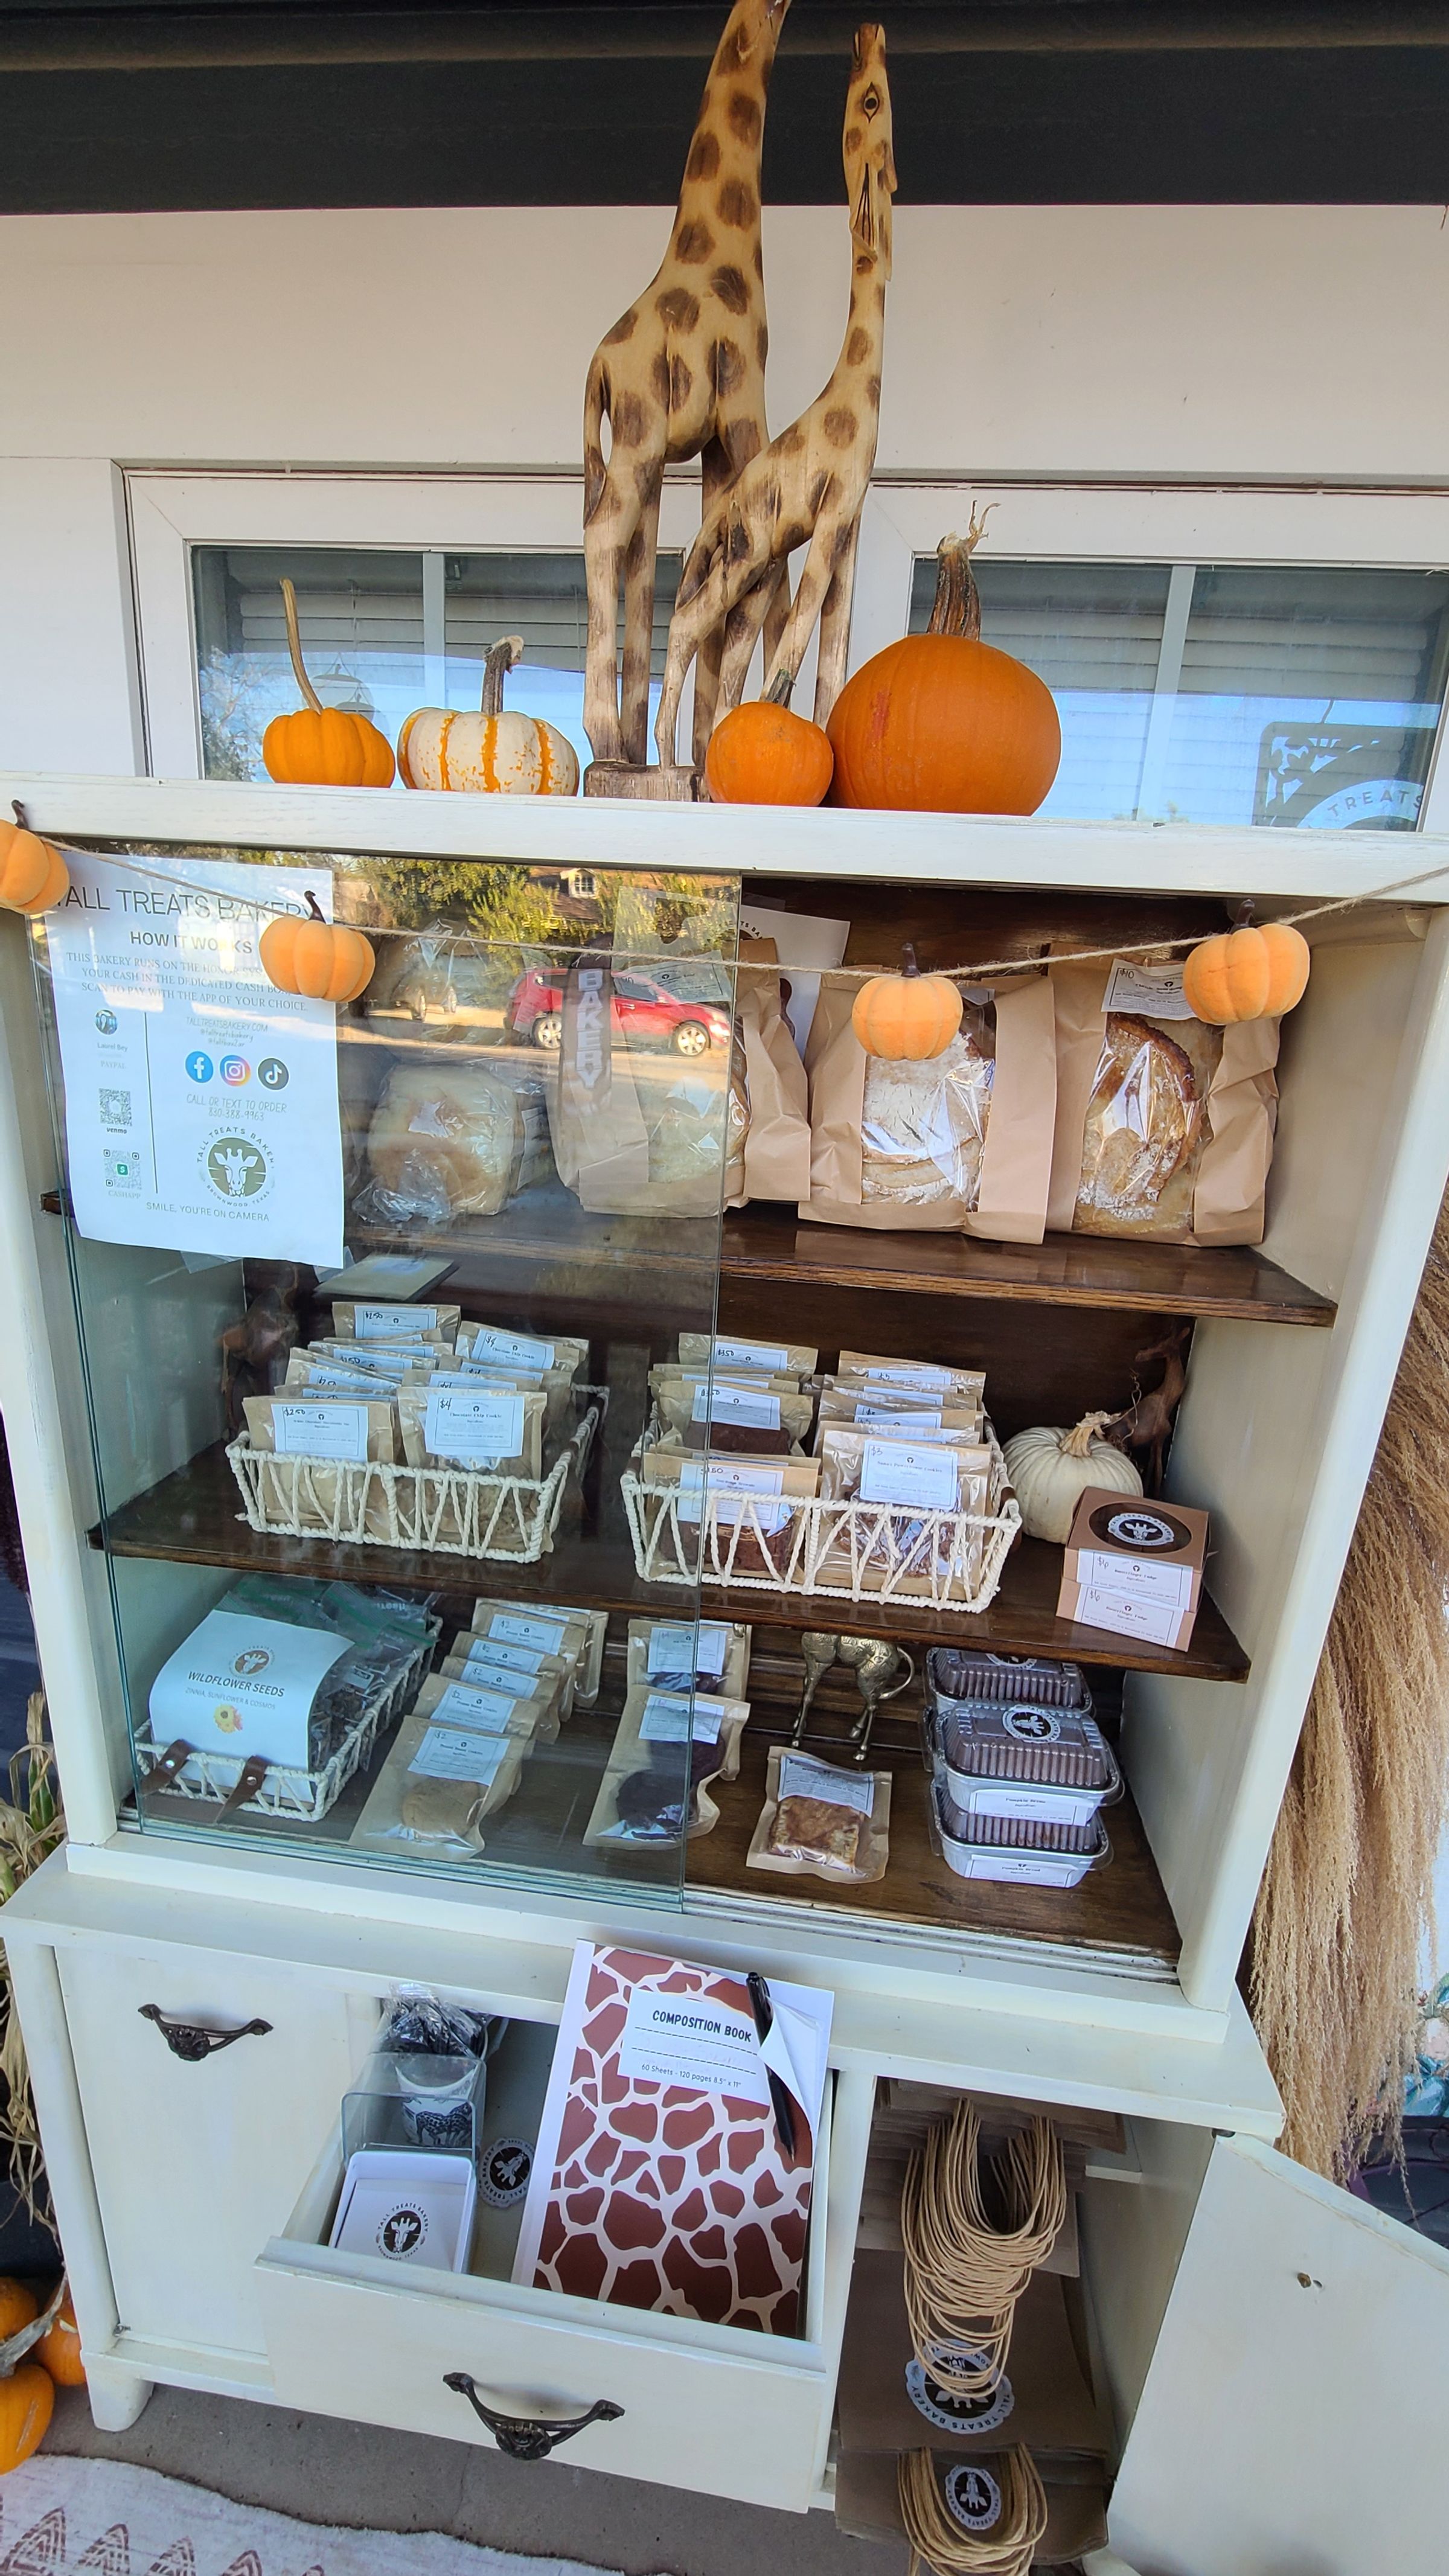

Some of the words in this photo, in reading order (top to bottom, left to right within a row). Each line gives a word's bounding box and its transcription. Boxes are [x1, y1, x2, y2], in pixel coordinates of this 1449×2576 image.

[1328, 790, 1422, 816] TREATS
[58, 886, 110, 910] ALL
[116, 889, 210, 919] TREATS
[130, 931, 169, 947] HOW
[174, 935, 188, 948] IT
[192, 936, 252, 954] WOKS
[66, 952, 91, 962] THIS
[94, 954, 132, 966] BAKERY
[134, 958, 160, 968] RUNS
[163, 960, 178, 970] ON
[181, 962, 200, 973] THE
[243, 967, 263, 977] SYS
[1119, 968, 1134, 979] $10
[82, 968, 110, 979] YOUR
[113, 970, 139, 982] CASH
[142, 973, 152, 982] IN
[155, 974, 174, 985] THE
[178, 976, 232, 990] DEDICATED
[235, 982, 264, 993] CASH
[82, 982, 107, 992] SCAN
[110, 985, 124, 993] TO
[128, 986, 146, 996] PAY
[147, 988, 174, 999] WITH
[177, 991, 198, 1001] THE
[200, 992, 217, 1002] APP
[219, 994, 232, 1004] OF
[235, 996, 266, 1008] YOUR
[187, 1094, 205, 1106] CALL
[209, 1096, 219, 1106] OR
[222, 1098, 242, 1109] TEXT
[246, 1099, 256, 1110] TO
[258, 1101, 287, 1113] ORDER
[197, 1140, 209, 1163] TALL
[209, 1127, 245, 1138] TREATS
[179, 1205, 211, 1216] YOU'RE
[213, 1209, 226, 1218] ON
[228, 1211, 270, 1222] CAMERA
[440, 1398, 452, 1411] $4
[188, 1671, 252, 1691] WILDFLOWER
[253, 1683, 286, 1697] SEEDS
[208, 1692, 244, 1704] SUNFLOWER
[250, 1699, 276, 1710] COSMOS
[653, 2010, 721, 2034] COMPOSITION
[724, 2025, 752, 2043] BOOK
[651, 2065, 673, 2076] Sheets
[680, 2071, 690, 2079] 120
[691, 2074, 712, 2083] pages
[912, 2385, 947, 2424] BAKERY
[952, 2415, 999, 2431] TREATS
